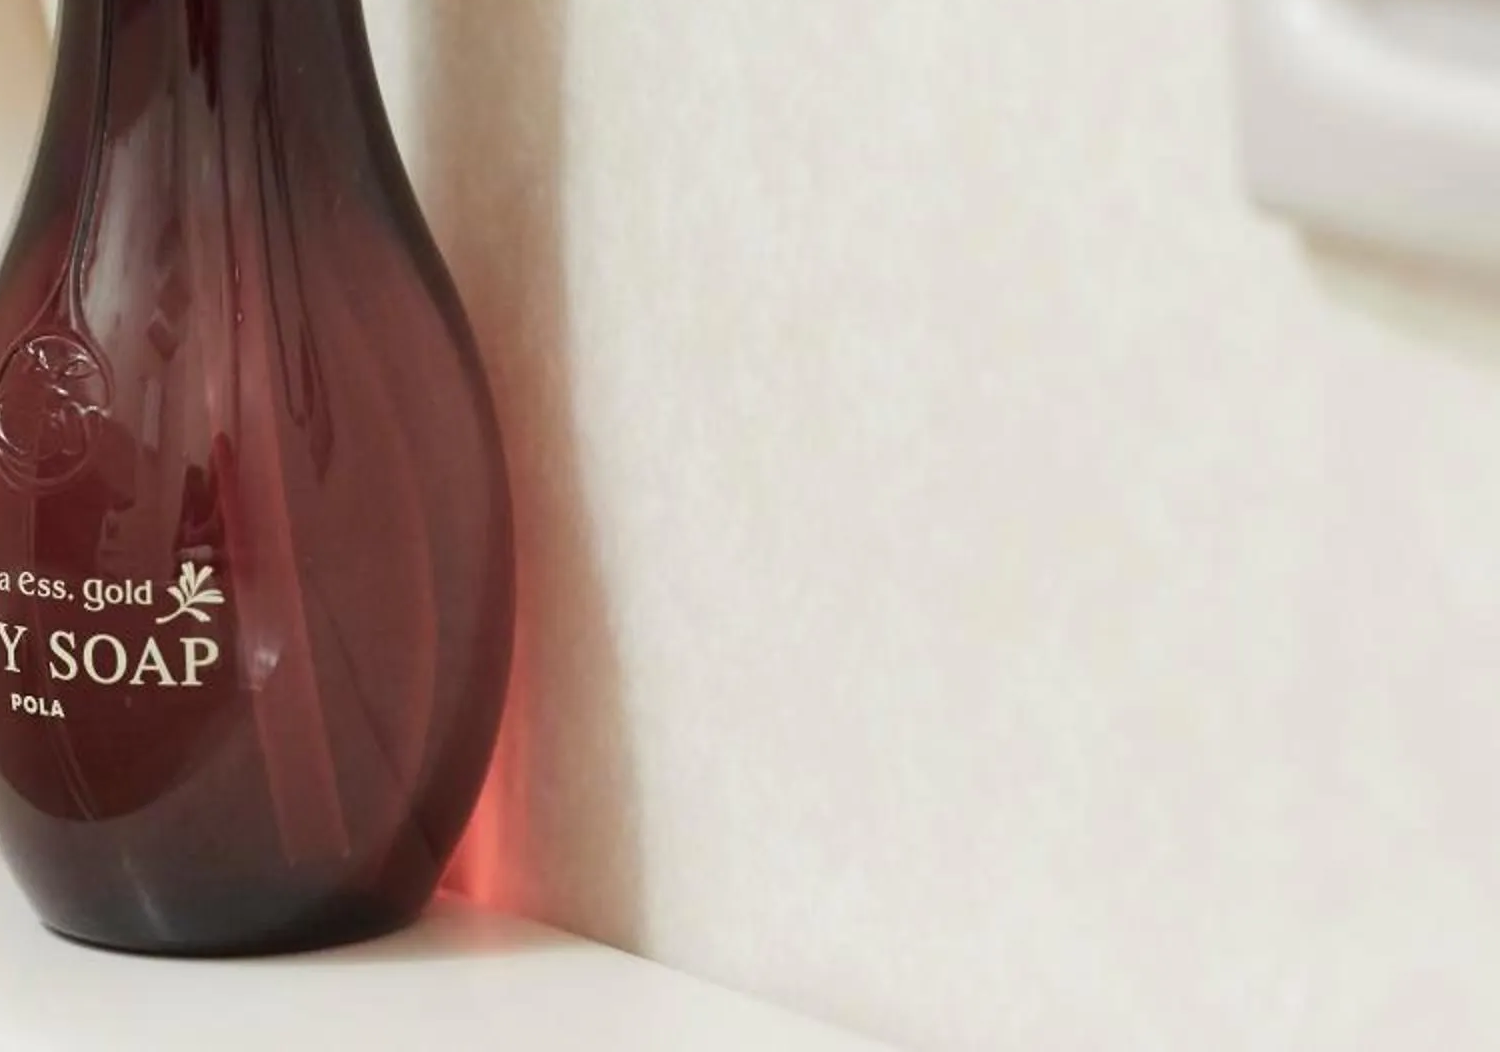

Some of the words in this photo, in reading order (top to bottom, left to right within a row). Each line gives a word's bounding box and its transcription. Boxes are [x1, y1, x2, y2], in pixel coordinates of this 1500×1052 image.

[18, 571, 74, 600] ess.
[83, 579, 153, 611] gold
[49, 631, 219, 686] SOAP
[11, 693, 65, 718] POLA
